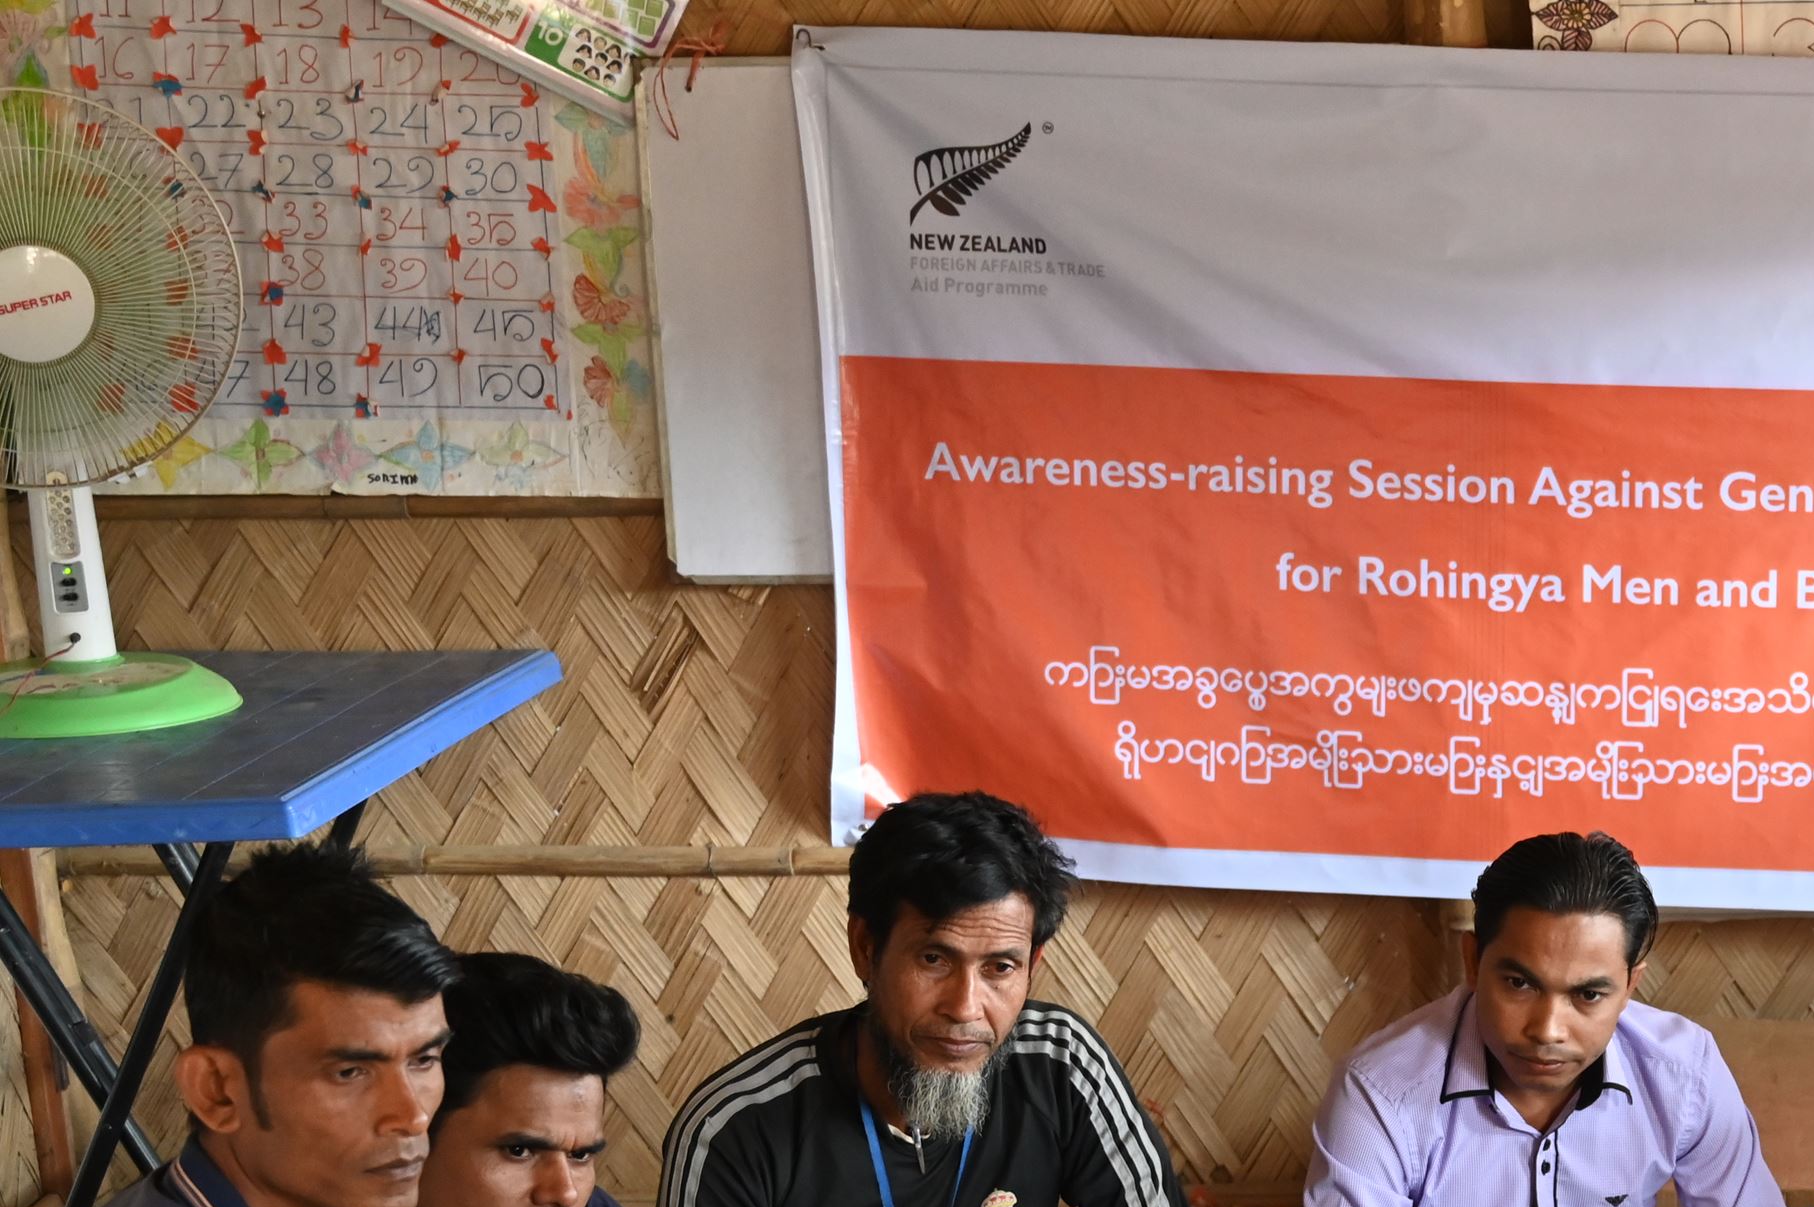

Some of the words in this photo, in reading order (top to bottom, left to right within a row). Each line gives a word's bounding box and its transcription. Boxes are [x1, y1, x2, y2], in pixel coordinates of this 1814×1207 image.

[537, 18, 565, 46] 10
[95, 36, 135, 80] 16
[186, 42, 230, 84] 17
[277, 44, 320, 85] 18
[372, 46, 423, 88] 19
[187, 94, 246, 130] 22
[277, 97, 344, 141] 23
[369, 103, 429, 141] 24
[458, 103, 522, 141] 25
[190, 152, 244, 188] 27
[277, 153, 336, 191] 28
[373, 156, 435, 192] 29
[466, 159, 518, 195] 30
[284, 201, 330, 242] 33
[379, 204, 428, 242] 34
[466, 210, 517, 247] 35
[910, 233, 955, 251] NEW
[960, 234, 1047, 254] ZEALAND
[281, 251, 328, 290] 38
[380, 256, 428, 291] 39
[464, 256, 518, 291] 40
[910, 256, 977, 272] FOREIGN
[980, 258, 1043, 274] AFFAIRS
[1045, 261, 1057, 275] &
[1057, 262, 1106, 278] TRADE
[911, 277, 939, 292] Aid
[944, 278, 1049, 297] Programme
[0, 298, 39, 316] SUPER
[41, 290, 72, 307] STAR
[284, 305, 336, 342] 43
[473, 309, 534, 342] 45
[284, 358, 336, 397] 48
[378, 360, 438, 397] 49
[479, 363, 545, 402] 50
[924, 442, 1333, 508] Awareness-raising
[1348, 459, 1515, 505] Session
[1529, 466, 1703, 519] Against
[1277, 552, 1341, 592] for
[1358, 555, 1565, 612] Rohingya
[1582, 564, 1678, 606] Men
[1696, 570, 1777, 608] and
